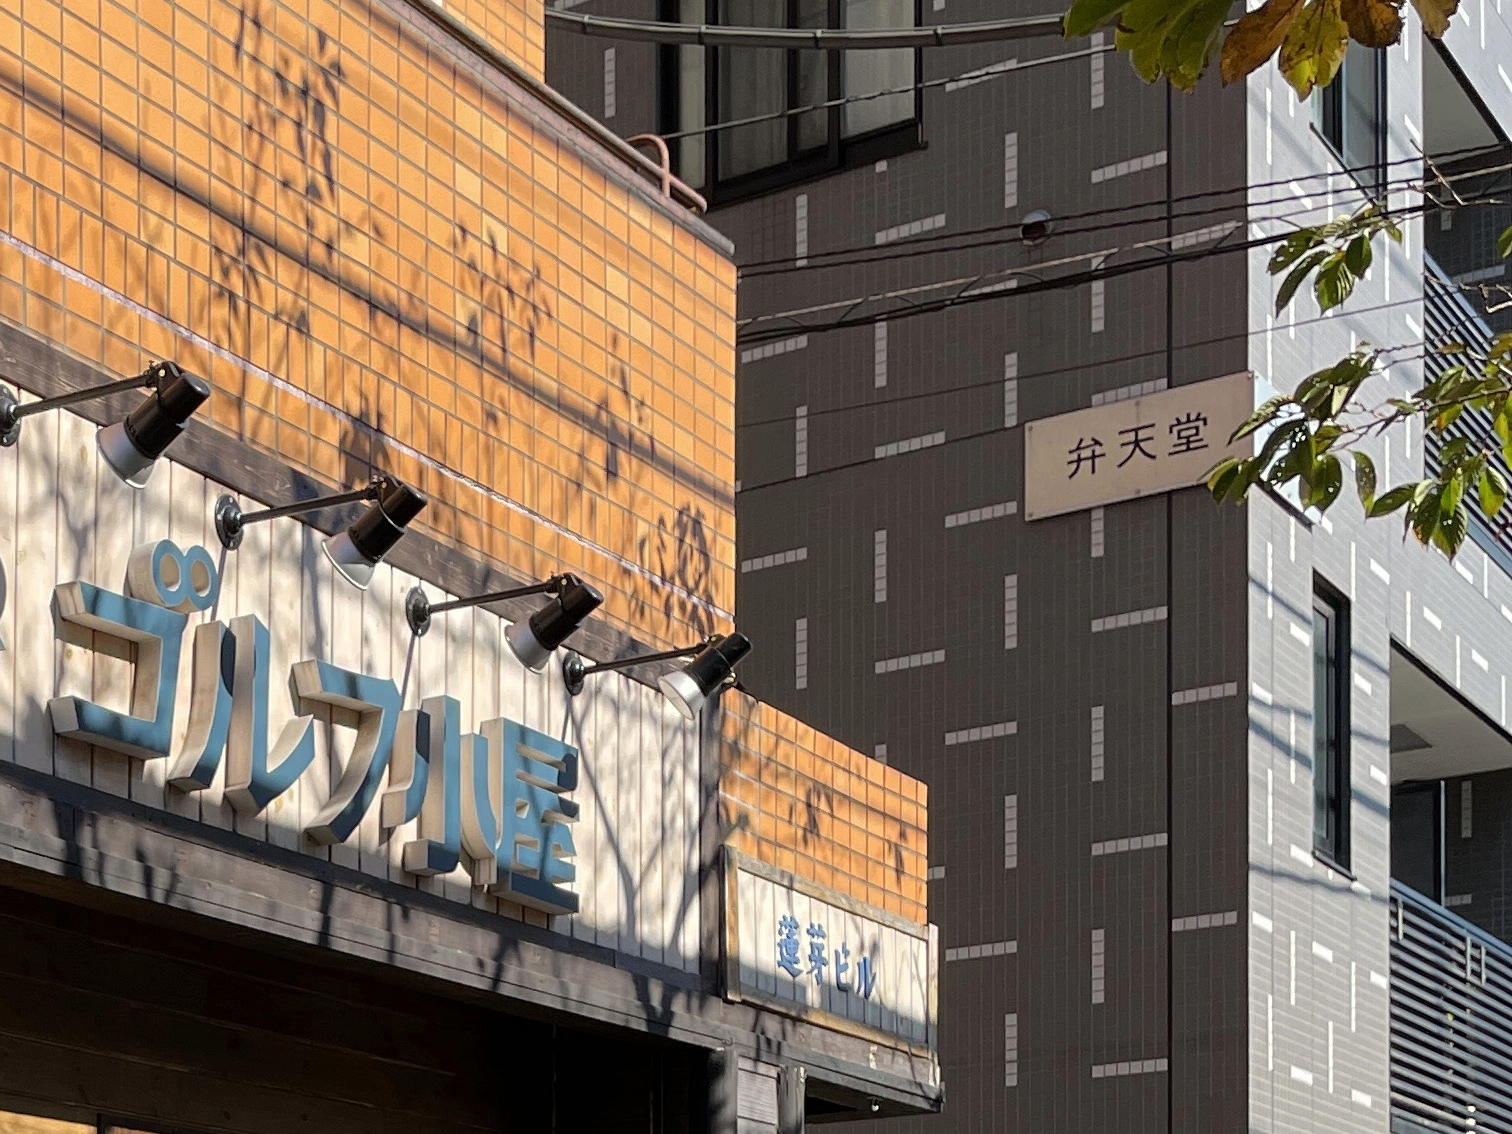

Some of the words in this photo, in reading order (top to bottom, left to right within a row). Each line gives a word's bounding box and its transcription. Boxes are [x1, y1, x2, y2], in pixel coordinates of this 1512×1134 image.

[1066, 411, 1210, 480] 弁天堂
[48, 538, 580, 916] ゴルフ小屋
